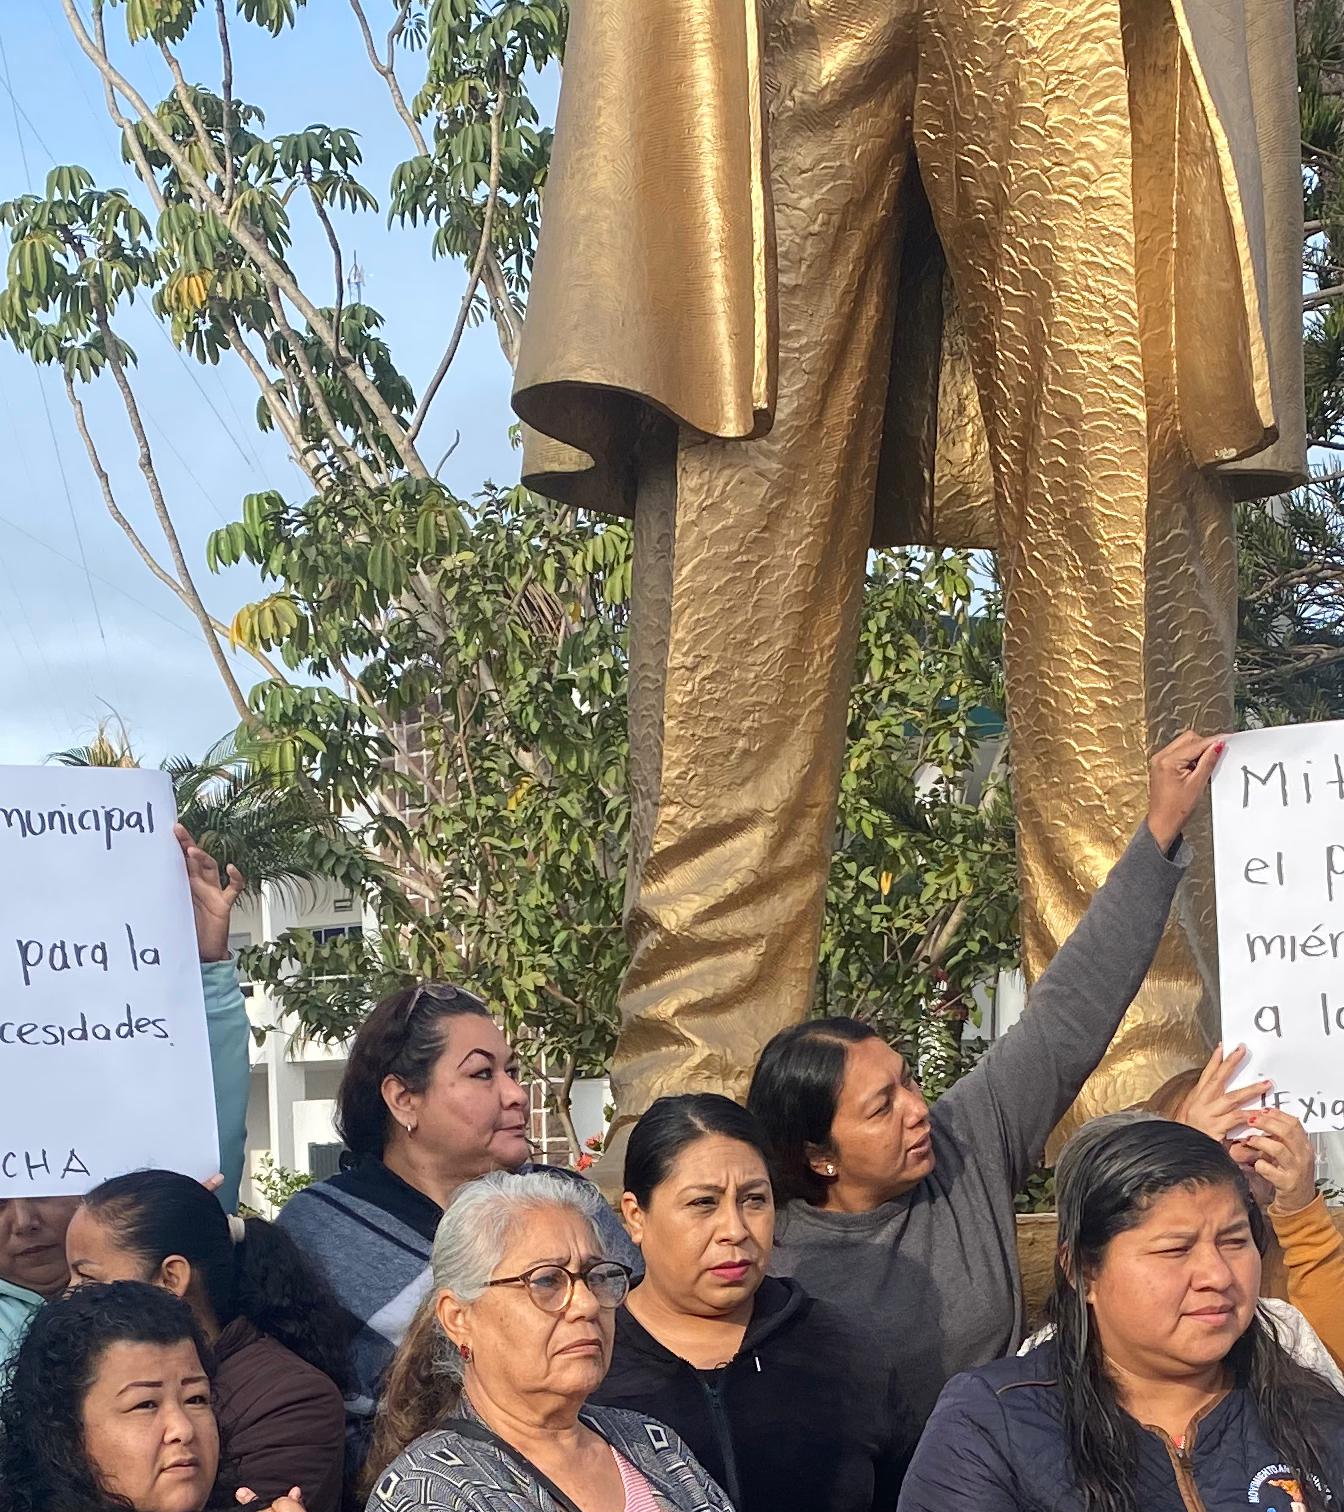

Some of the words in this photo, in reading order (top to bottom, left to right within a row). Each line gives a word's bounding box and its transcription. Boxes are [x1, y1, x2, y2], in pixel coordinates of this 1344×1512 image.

[1243, 851, 1283, 886] el
[18, 936, 110, 985] para
[126, 924, 161, 967] la
[1255, 1002, 1282, 1038] a
